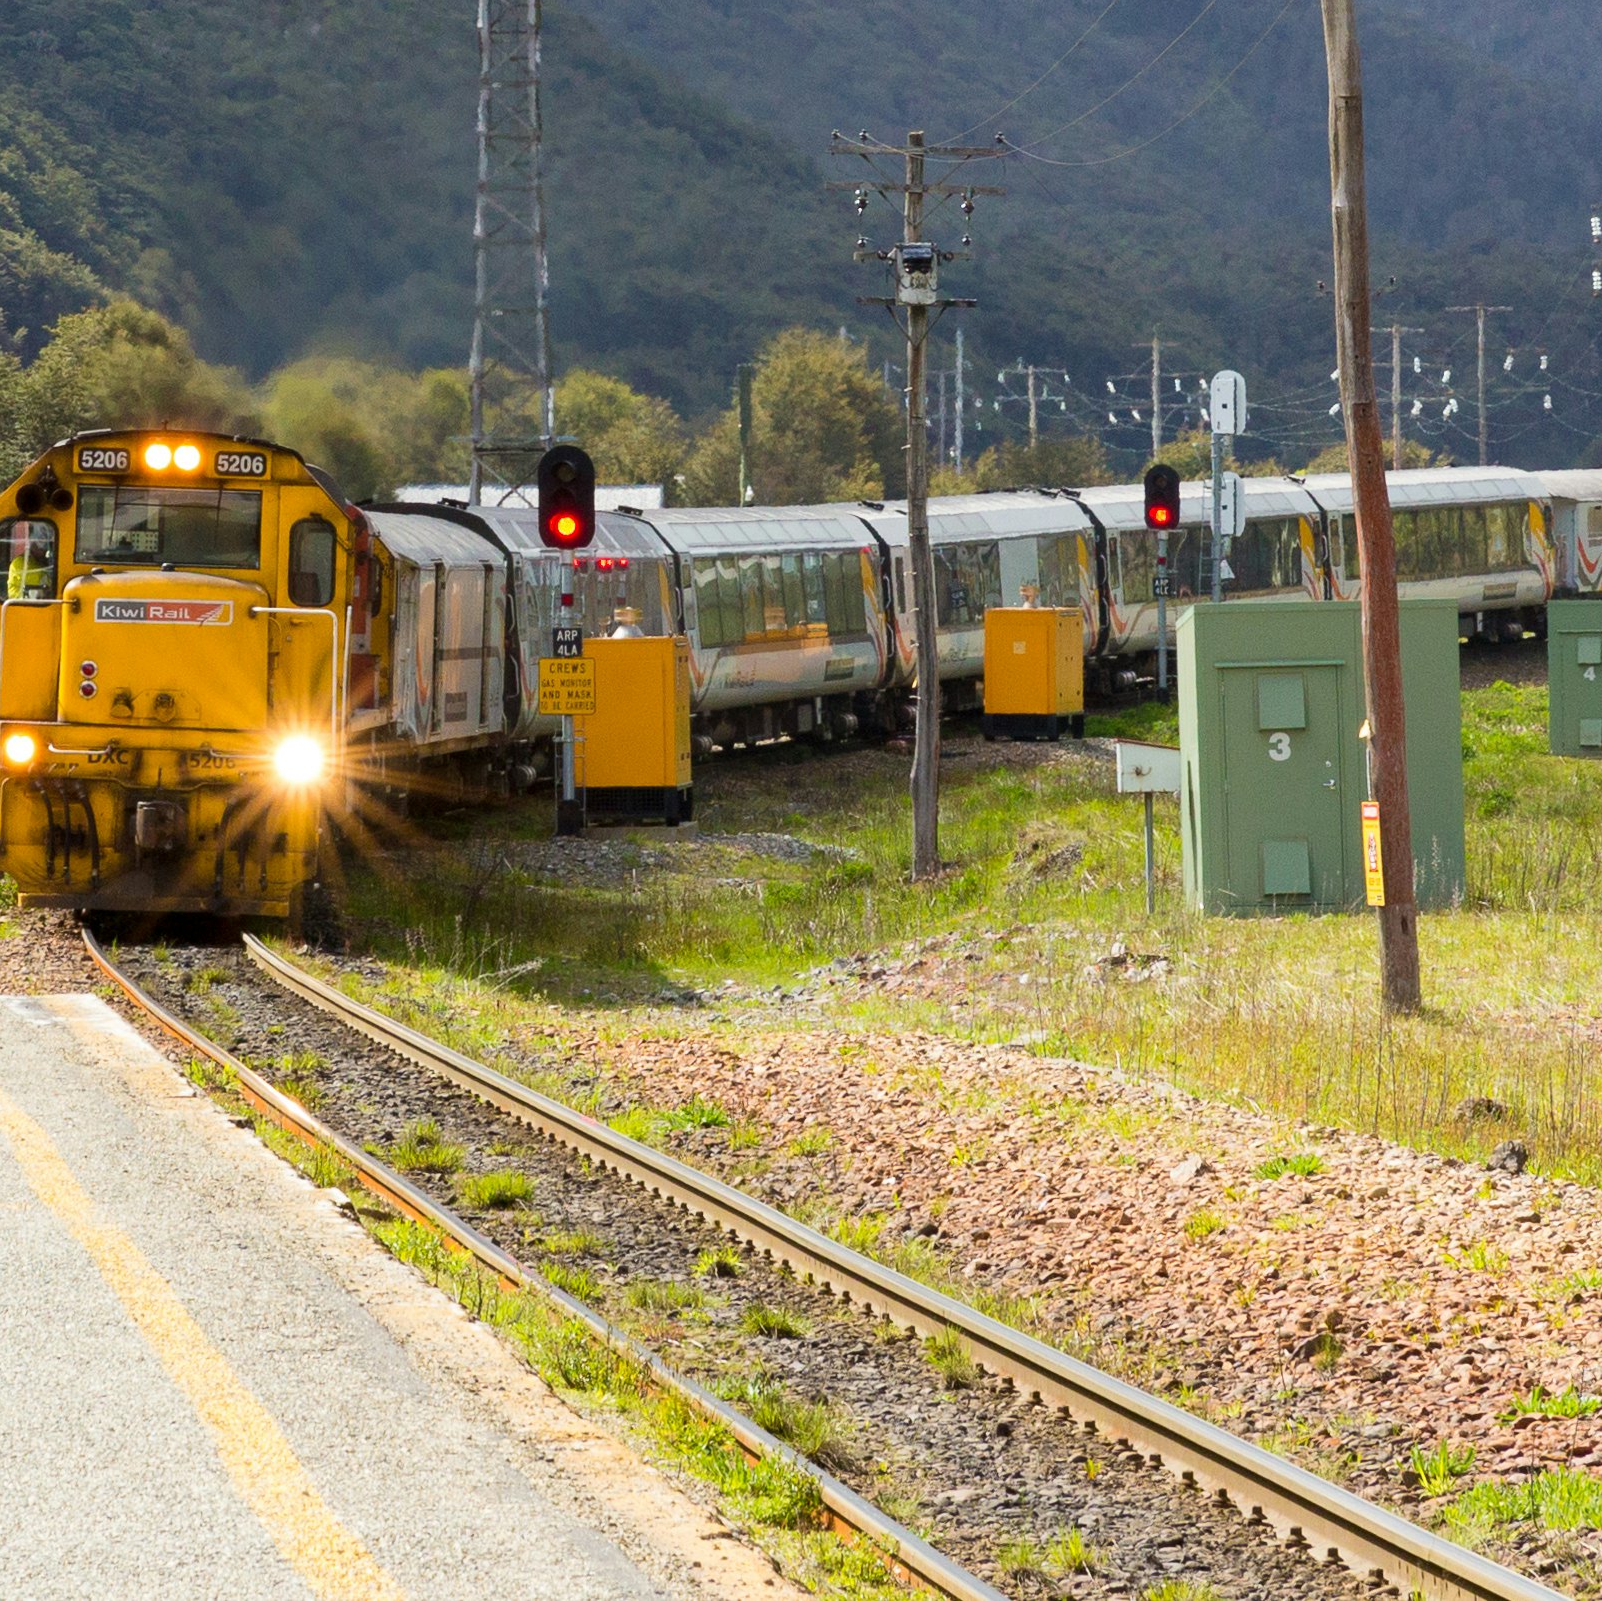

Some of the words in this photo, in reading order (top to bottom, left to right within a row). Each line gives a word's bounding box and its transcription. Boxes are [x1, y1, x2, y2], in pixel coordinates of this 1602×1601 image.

[81, 451, 128, 469] 5206
[217, 454, 264, 473] 5206
[101, 605, 190, 619] KiwiRail
[557, 630, 578, 641] ARP
[557, 645, 578, 655] 4LA
[549, 663, 586, 674] CREWS
[1583, 666, 1596, 681] 4
[541, 679, 555, 688] GAS
[560, 679, 592, 688] MONITOR
[542, 690, 561, 699] AND
[567, 690, 592, 699] MASK
[565, 701, 596, 710] CARRIED
[1268, 731, 1292, 761] 3
[189, 752, 236, 769] 5206
